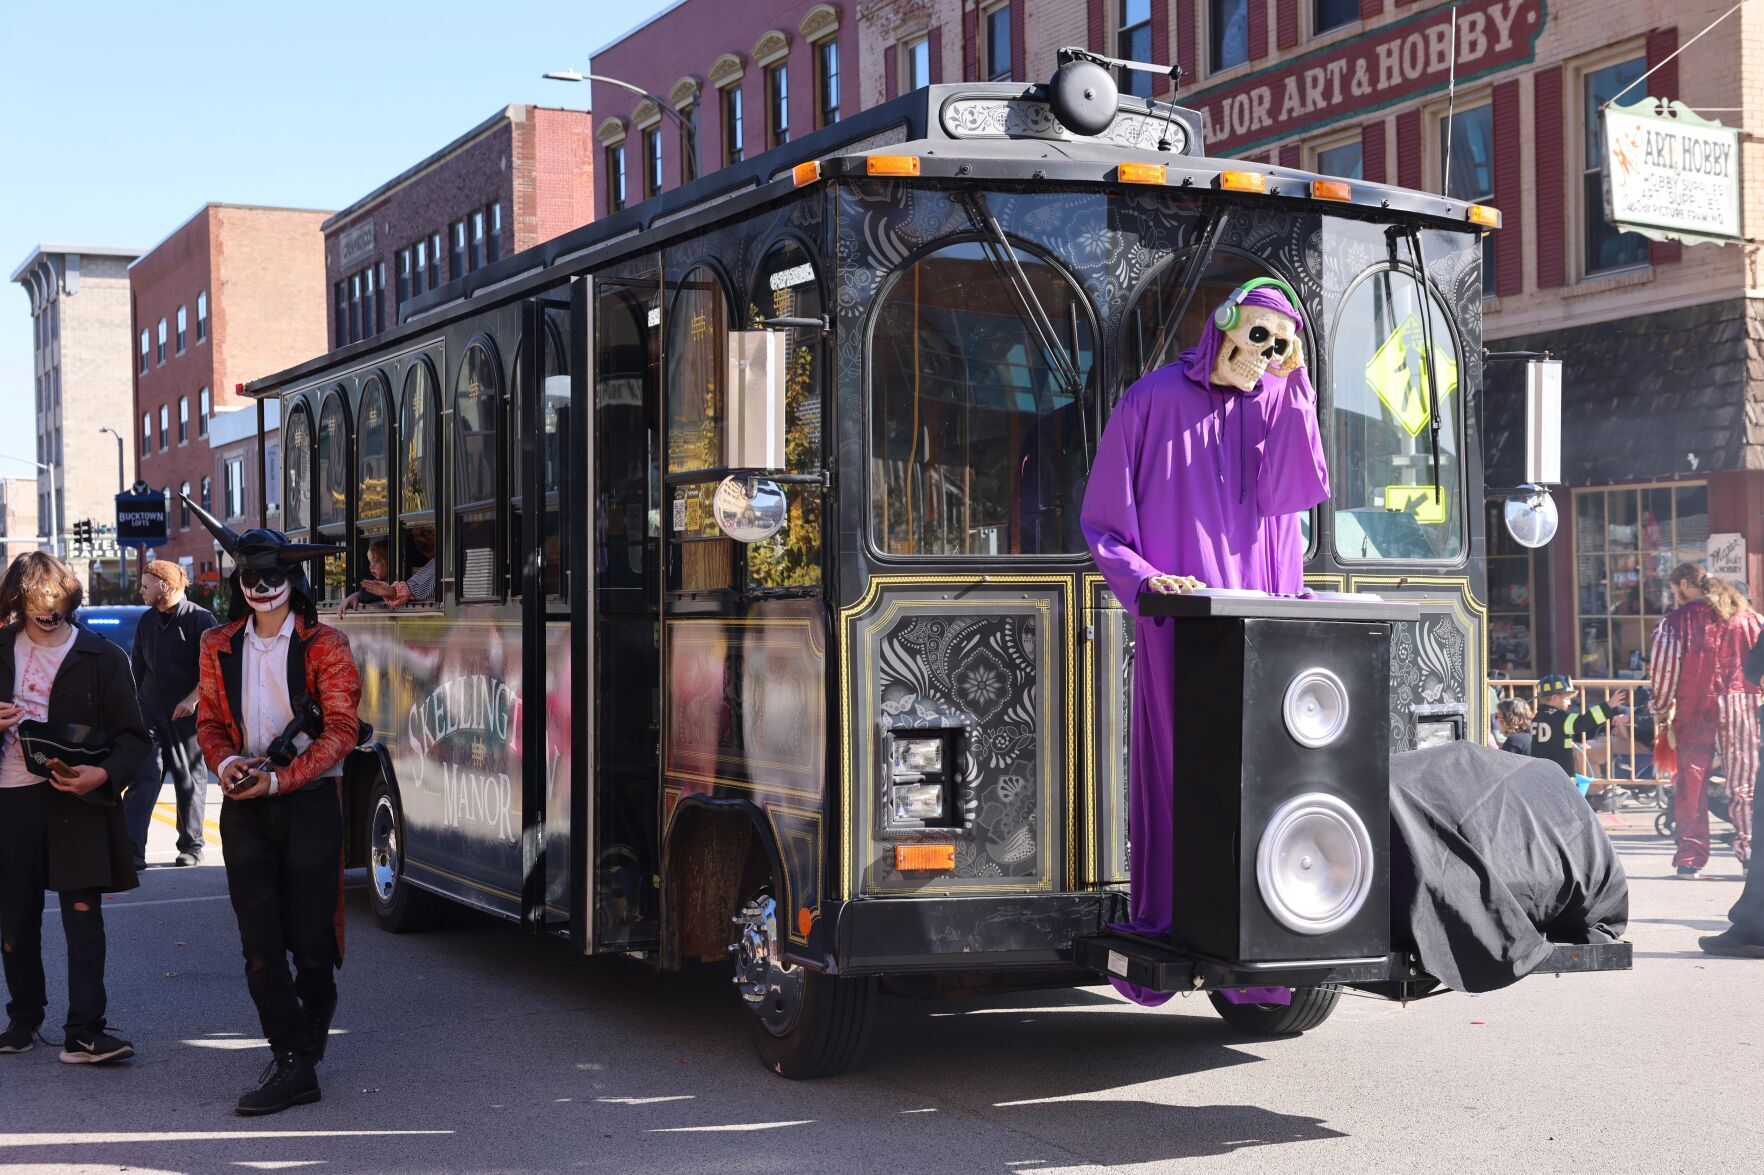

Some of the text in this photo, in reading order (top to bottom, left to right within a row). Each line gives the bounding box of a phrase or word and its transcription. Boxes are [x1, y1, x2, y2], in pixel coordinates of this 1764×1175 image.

[1200, 0, 1524, 145] AJOR ART & HOBBY
[1644, 130, 1677, 169] ART
[1681, 135, 1731, 178] HOBBY
[119, 511, 164, 522] BUCKTOWN
[408, 674, 560, 800] SKELLINGTN
[443, 761, 517, 844] MANOR
